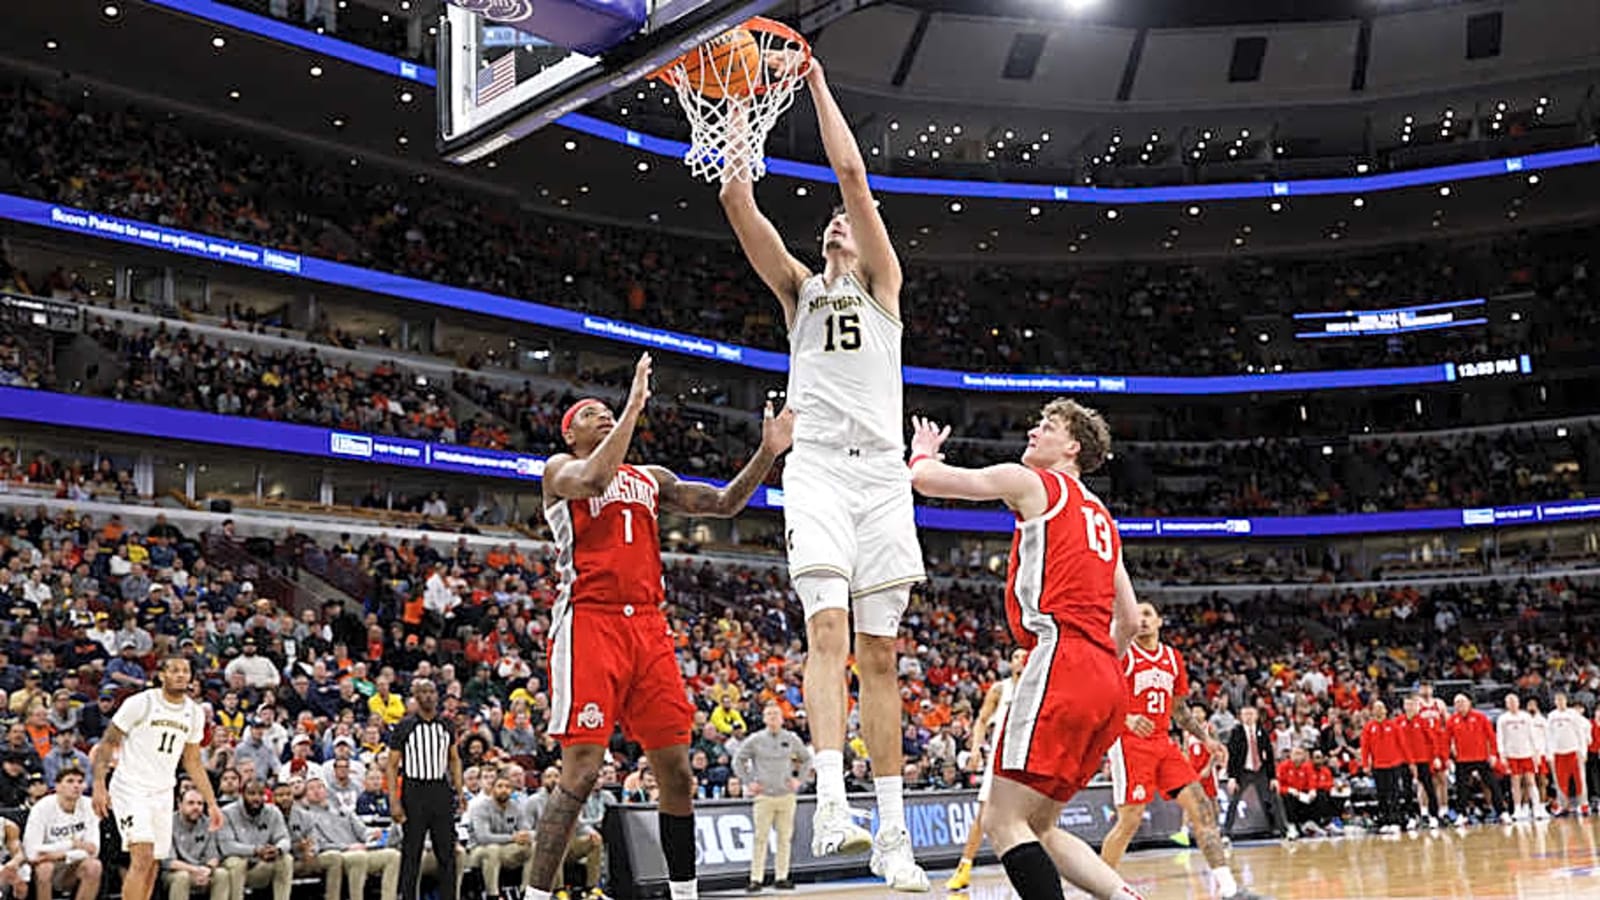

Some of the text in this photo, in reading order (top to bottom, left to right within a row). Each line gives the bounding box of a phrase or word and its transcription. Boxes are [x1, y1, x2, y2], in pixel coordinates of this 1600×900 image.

[824, 313, 862, 352] 15
[1496, 358, 1517, 373] PM
[621, 508, 634, 544] 1
[1080, 506, 1113, 563] 13
[1147, 690, 1166, 714] 21
[157, 731, 177, 754] 11
